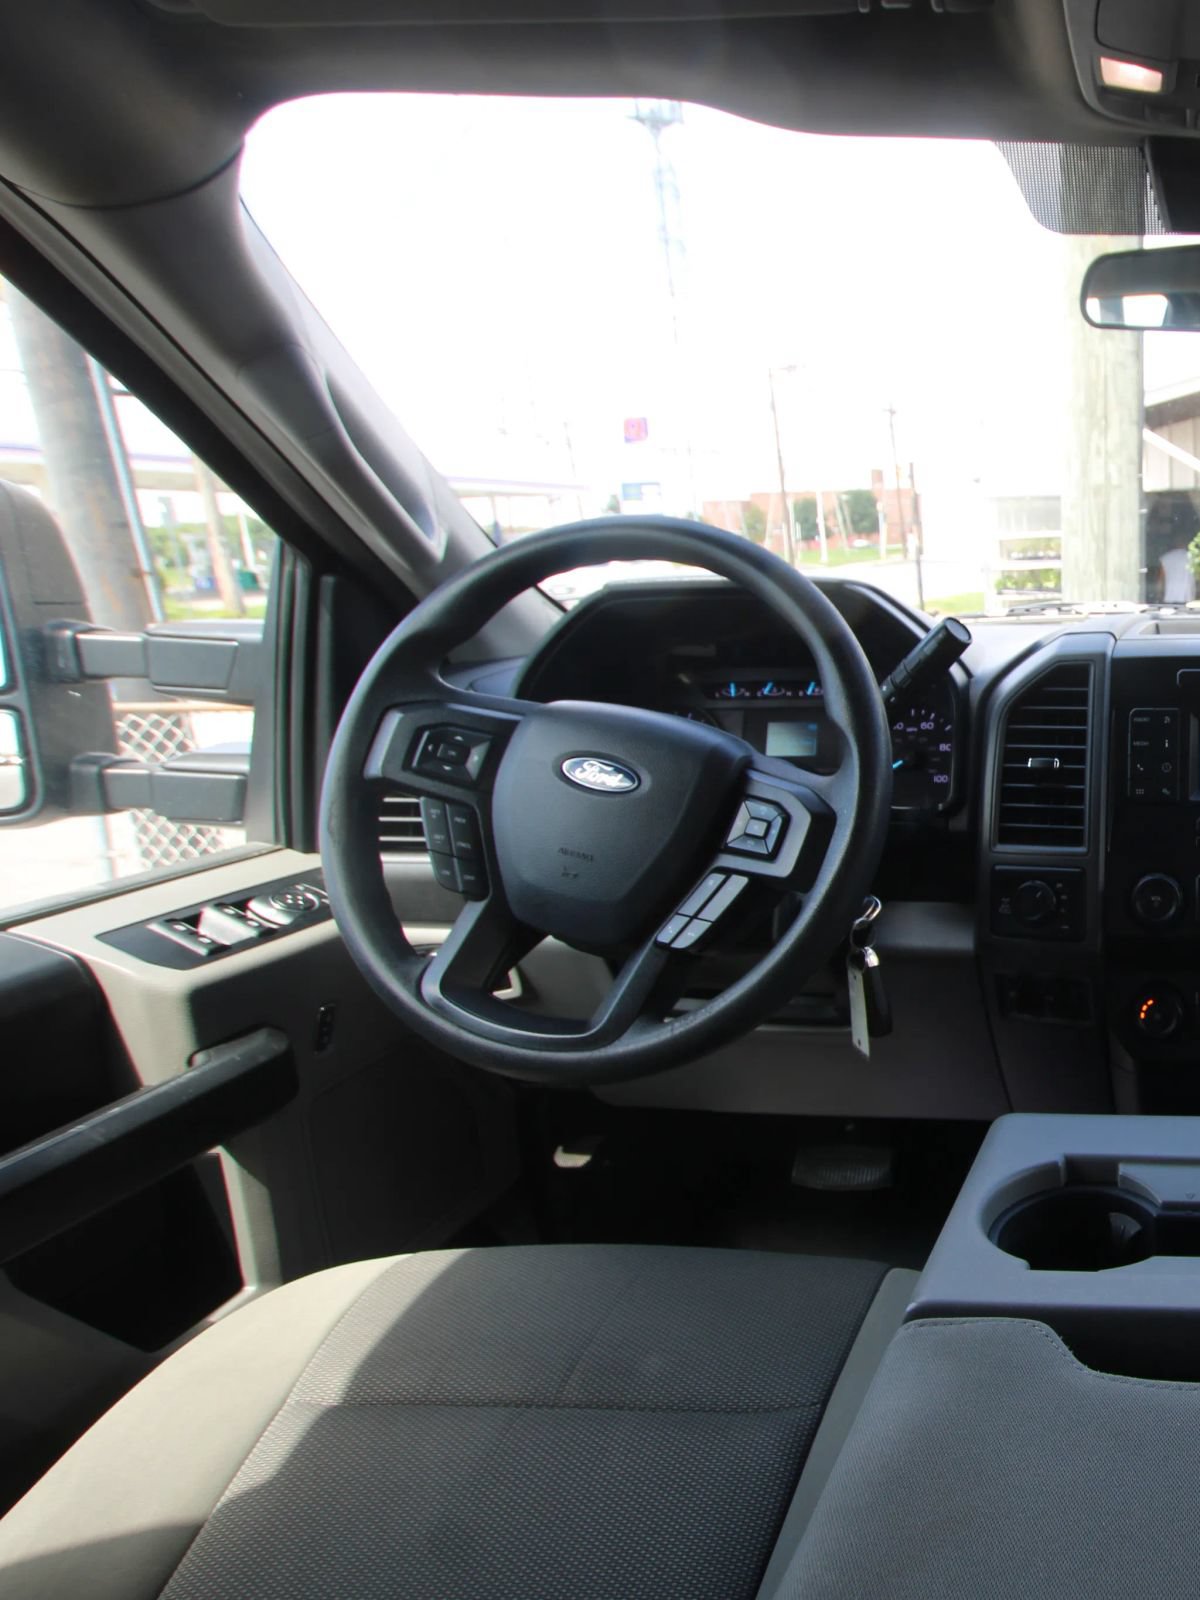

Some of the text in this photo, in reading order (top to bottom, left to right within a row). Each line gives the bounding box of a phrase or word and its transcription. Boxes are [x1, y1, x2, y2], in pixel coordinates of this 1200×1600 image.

[920, 722, 935, 730] 60
[574, 760, 633, 788] Ford
[933, 775, 949, 783] 100
